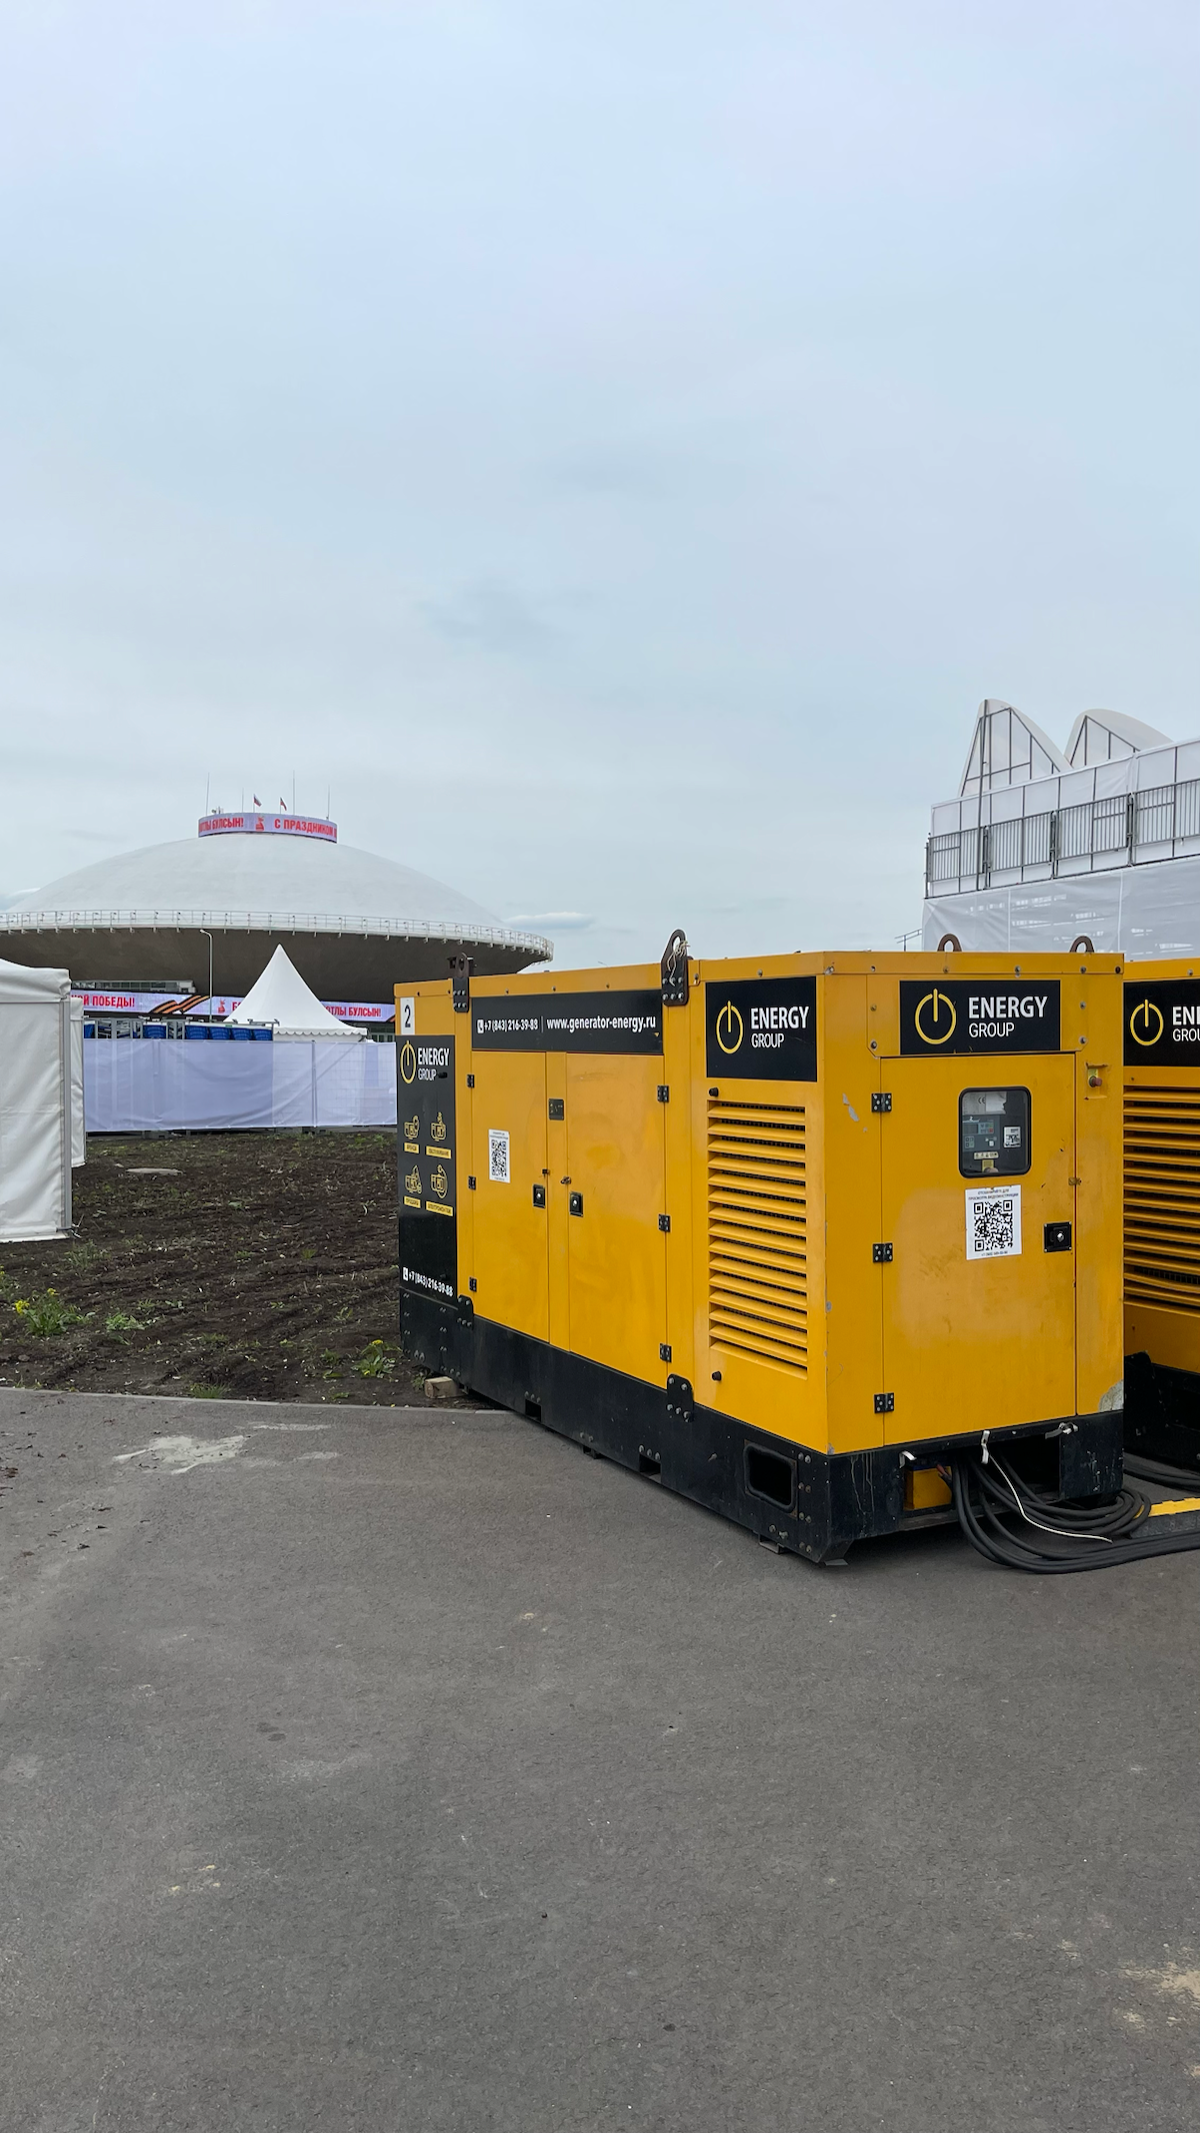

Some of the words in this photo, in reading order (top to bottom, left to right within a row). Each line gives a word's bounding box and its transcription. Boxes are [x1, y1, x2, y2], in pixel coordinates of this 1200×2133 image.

[274, 818, 281, 829] С
[92, 995, 135, 1008] ПОБЕДЫ!
[968, 996, 1048, 1018] ENERGY
[348, 1007, 381, 1017] БУЛСЫН!
[404, 1004, 411, 1028] 2
[751, 1006, 809, 1029] ENERGY
[484, 1020, 492, 1031] +7
[546, 1015, 656, 1033] www.generator-energy.ru
[968, 1022, 1015, 1038] GROUP
[751, 1033, 785, 1048] GROUP
[418, 1047, 450, 1066] ENERGY
[418, 1068, 437, 1081] GROUP
